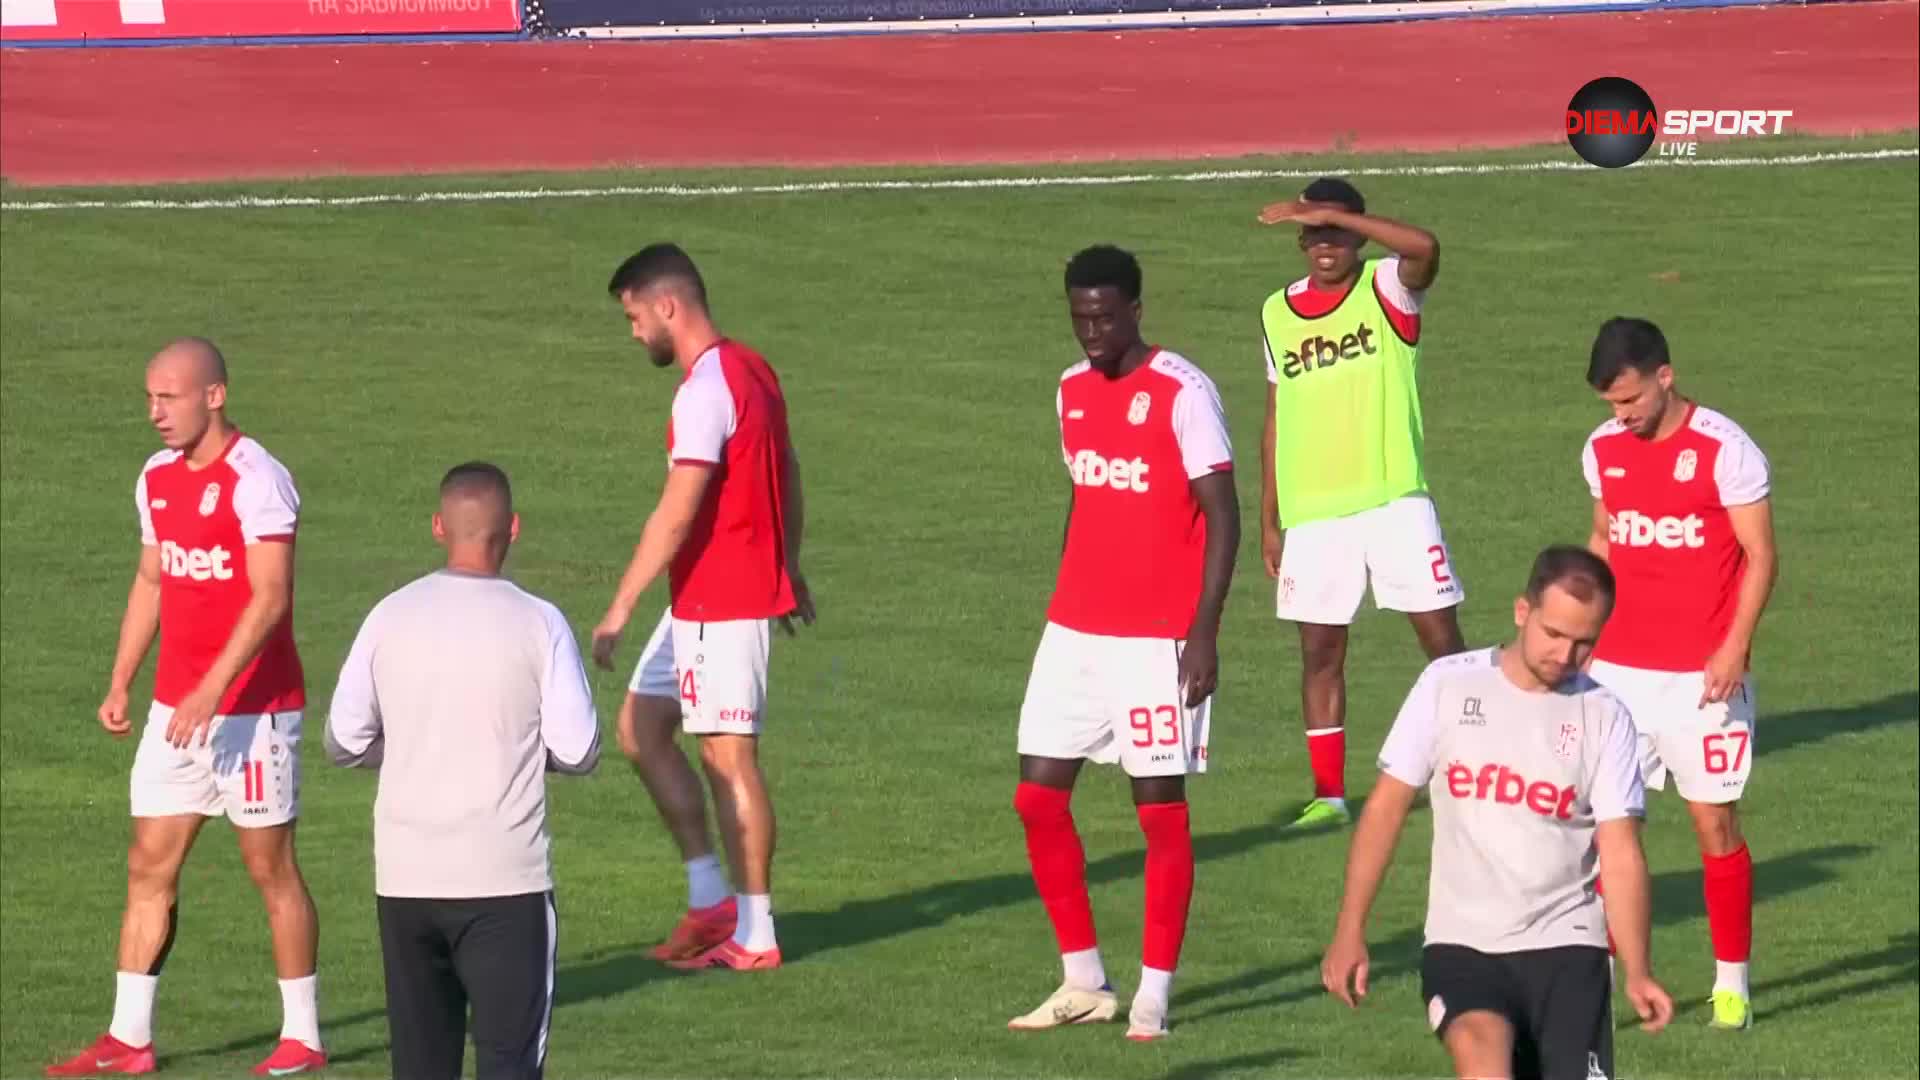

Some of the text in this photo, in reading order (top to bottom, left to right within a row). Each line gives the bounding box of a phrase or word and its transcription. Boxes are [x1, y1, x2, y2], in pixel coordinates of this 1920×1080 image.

[1283, 322, 1377, 379] efbet
[1427, 544, 1451, 582] 2
[1129, 705, 1179, 747] 93
[1703, 730, 1749, 774] 67
[244, 759, 264, 802] 11
[1447, 762, 1578, 820] efbet
